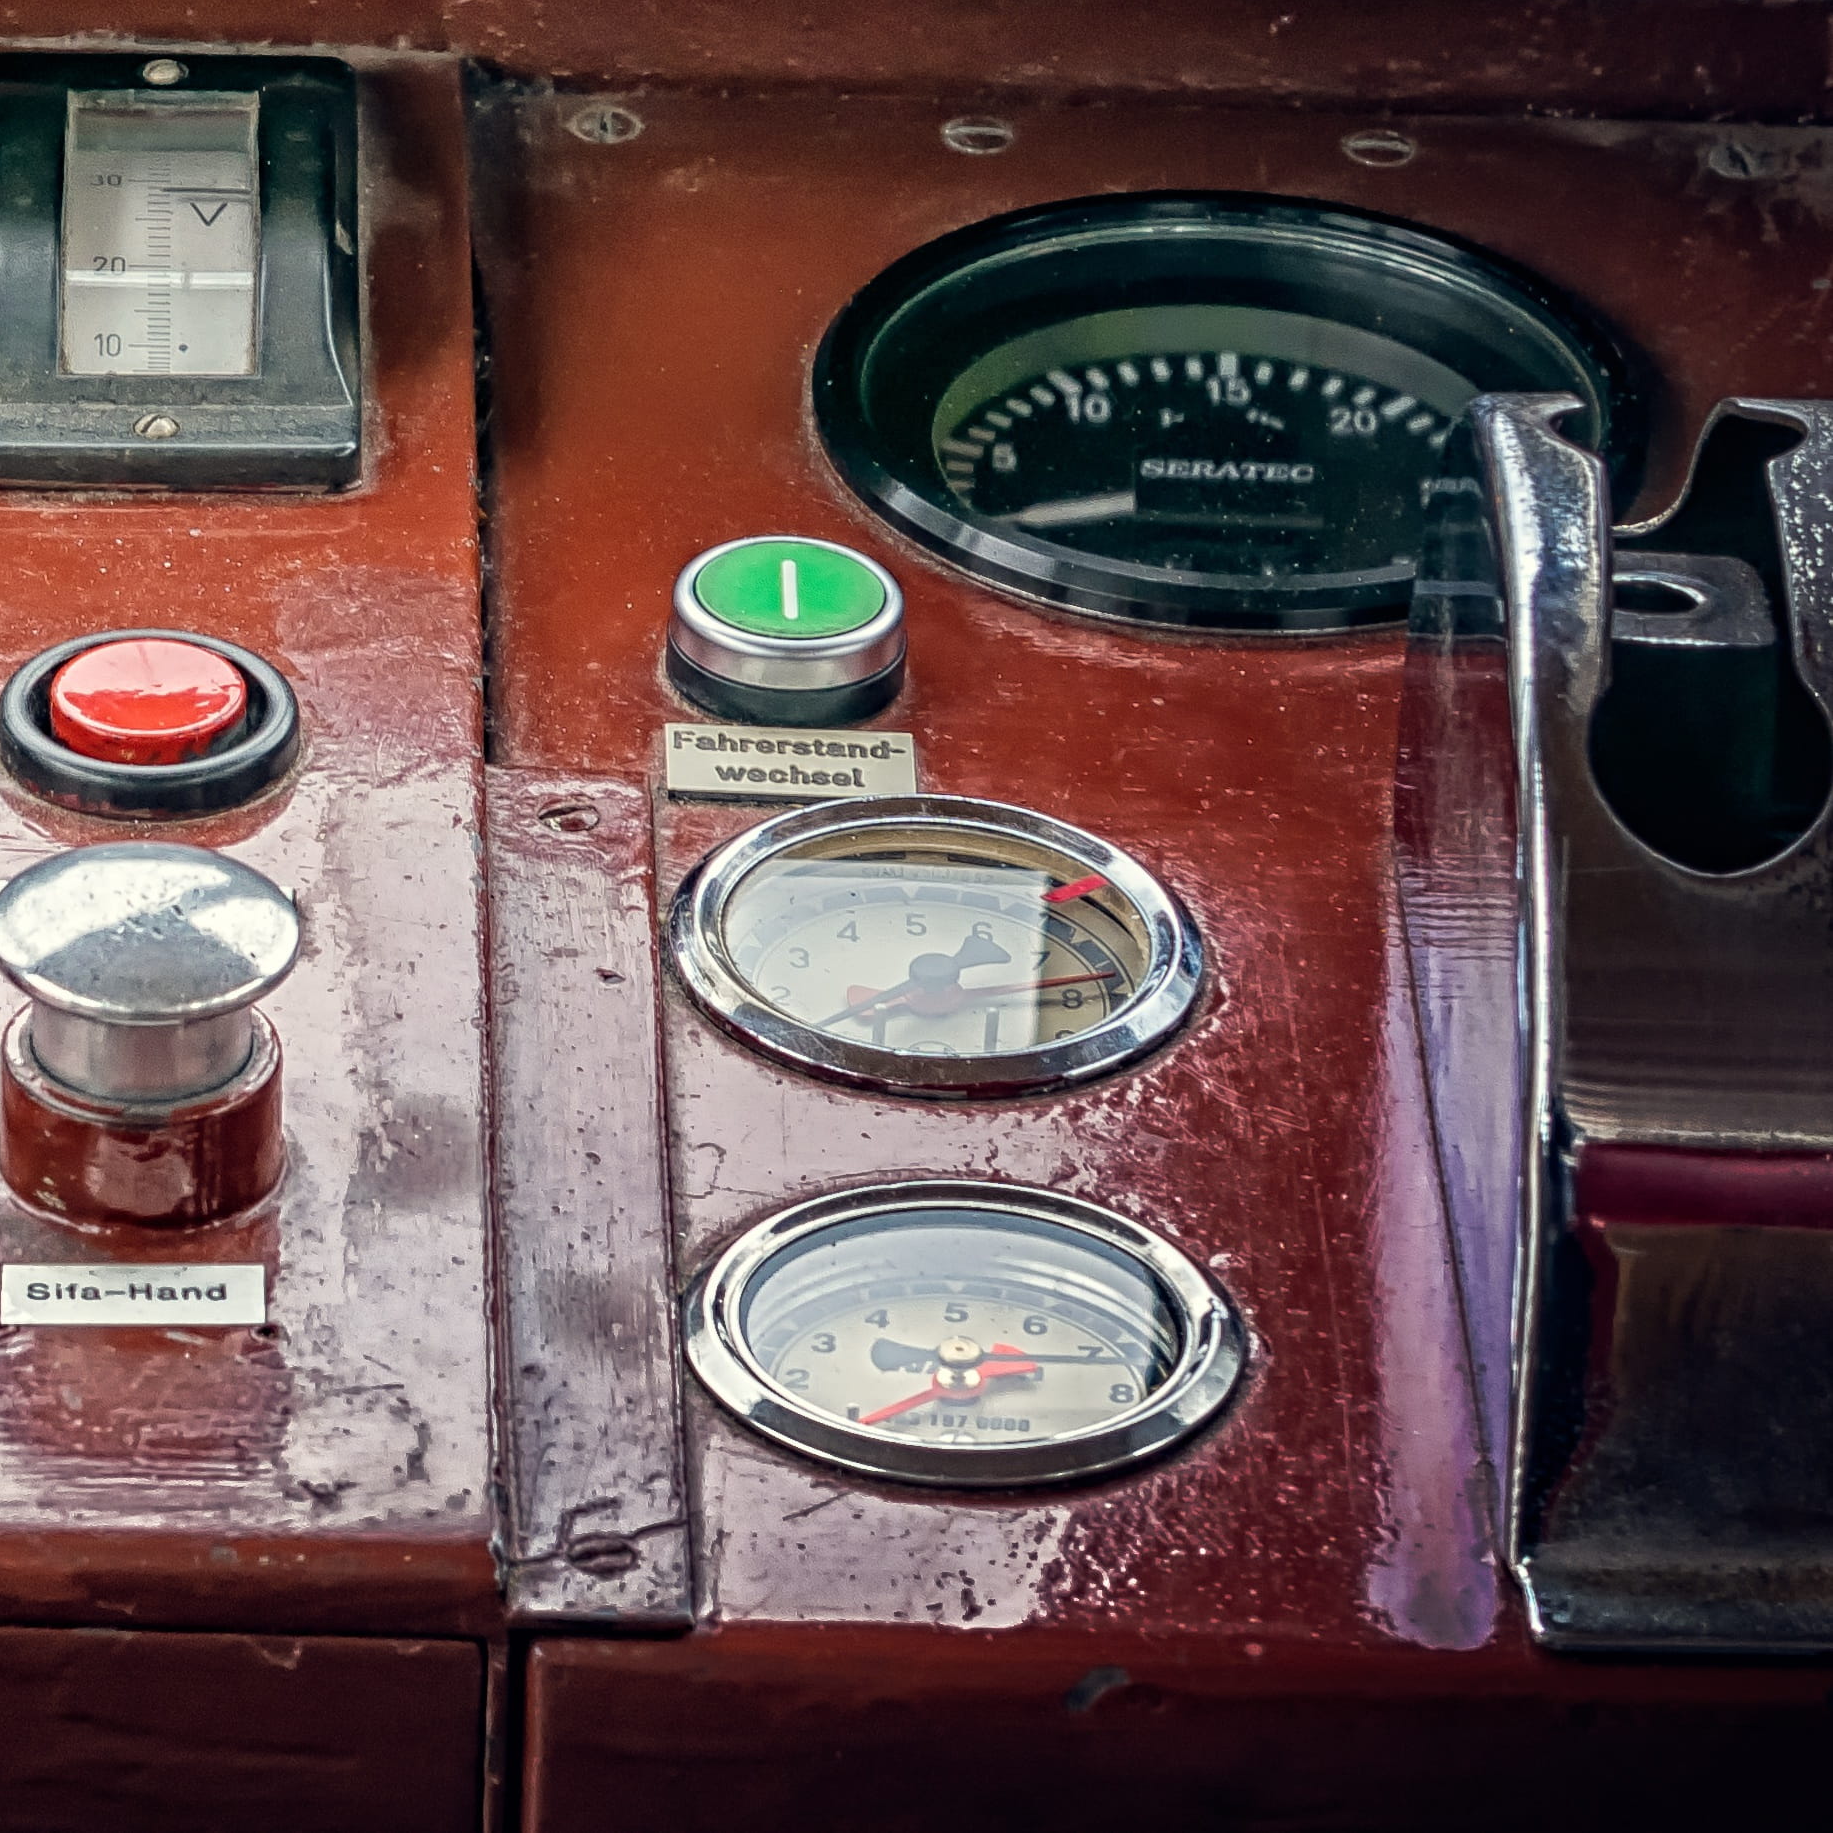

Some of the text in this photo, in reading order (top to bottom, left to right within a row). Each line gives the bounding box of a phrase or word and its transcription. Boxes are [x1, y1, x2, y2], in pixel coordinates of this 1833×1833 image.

[90, 173, 123, 187] 30
[189, 201, 228, 227] V
[92, 255, 127, 273] 20
[93, 332, 122, 358] 10
[1067, 392, 1111, 424] 10
[1330, 407, 1378, 436] 20
[1139, 457, 1315, 483] SERATEC
[672, 730, 907, 760] Fahrerstand-
[714, 764, 867, 788] wechsel
[835, 920, 860, 943] 4
[905, 913, 928, 937] 5
[789, 947, 811, 969] 3
[1030, 950, 1052, 971] 7
[770, 986, 792, 1007] 2
[1060, 988, 1084, 1010] 8
[26, 1282, 228, 1302] Sifa-Hand
[864, 1308, 890, 1330] 4
[944, 1301, 970, 1324] 5
[1023, 1315, 1049, 1337] 6
[811, 1333, 837, 1354] 3
[785, 1368, 810, 1391] 2
[1109, 1383, 1135, 1405] 8
